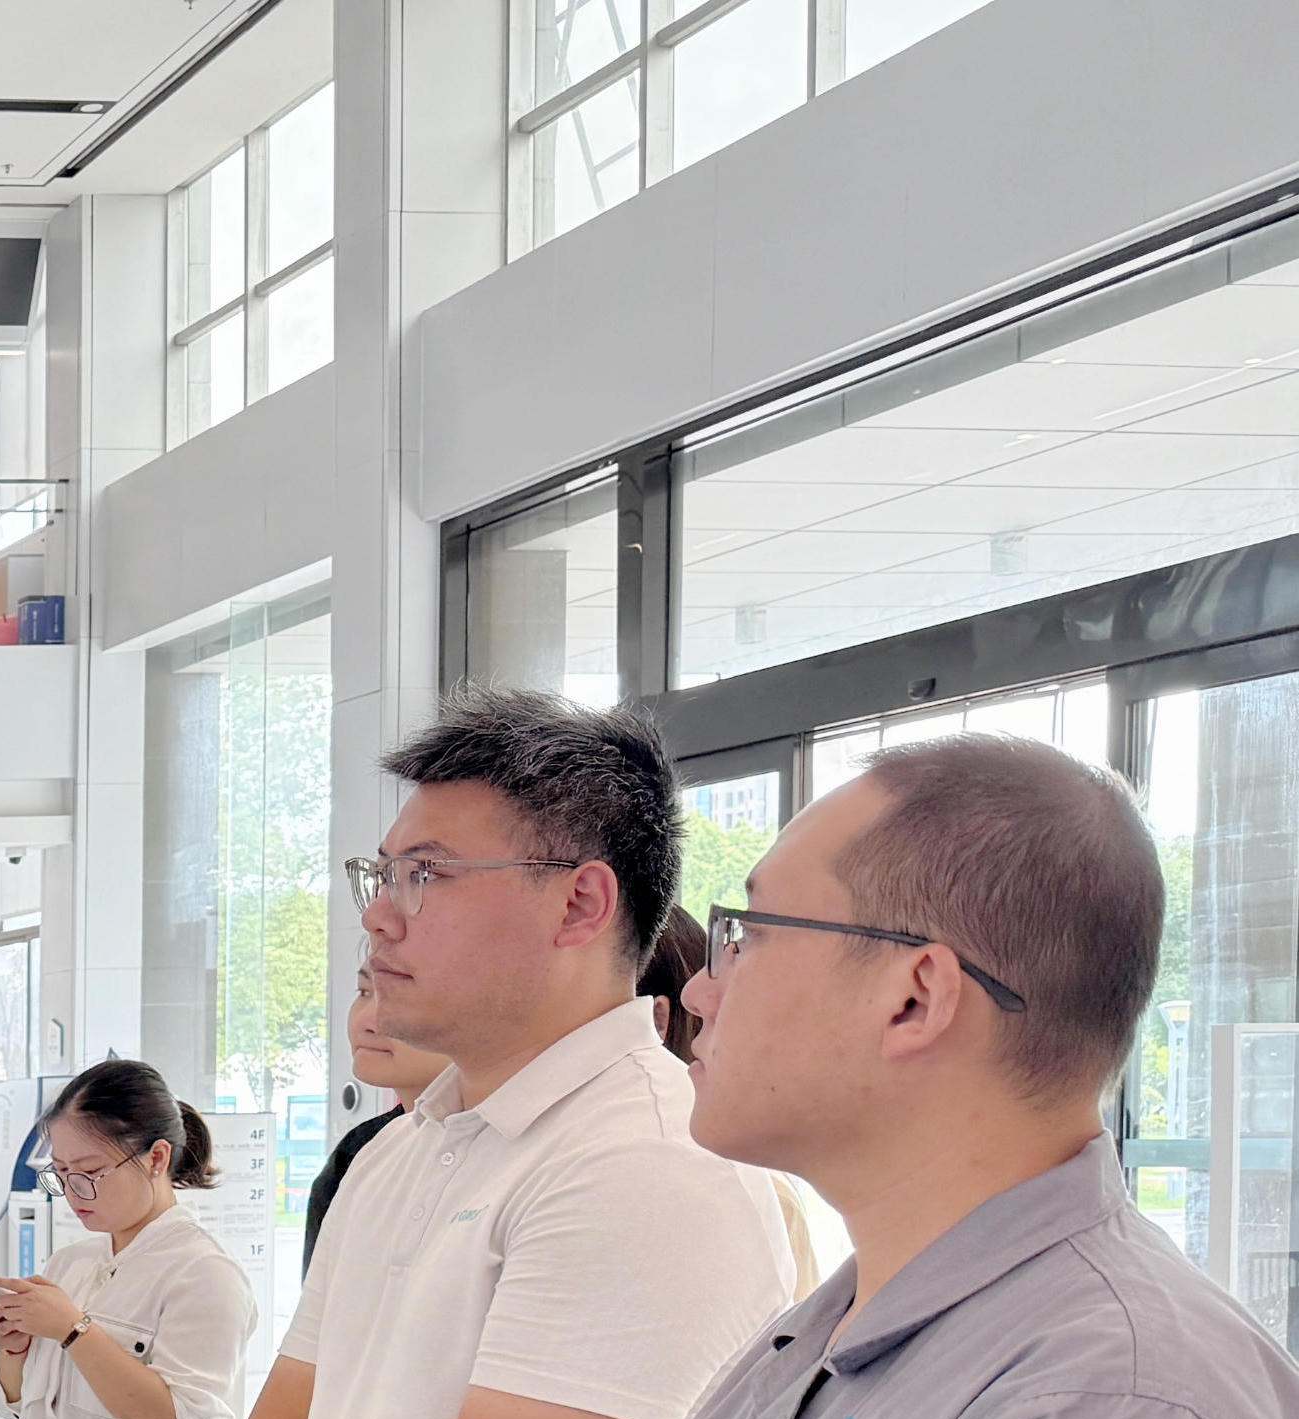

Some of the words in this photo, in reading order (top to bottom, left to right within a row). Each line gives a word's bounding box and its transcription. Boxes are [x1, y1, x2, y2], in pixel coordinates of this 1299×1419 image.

[250, 1129, 265, 1141] 4F
[250, 1158, 265, 1170] 3F
[250, 1189, 265, 1200] 2F
[251, 1244, 265, 1255] 1F
